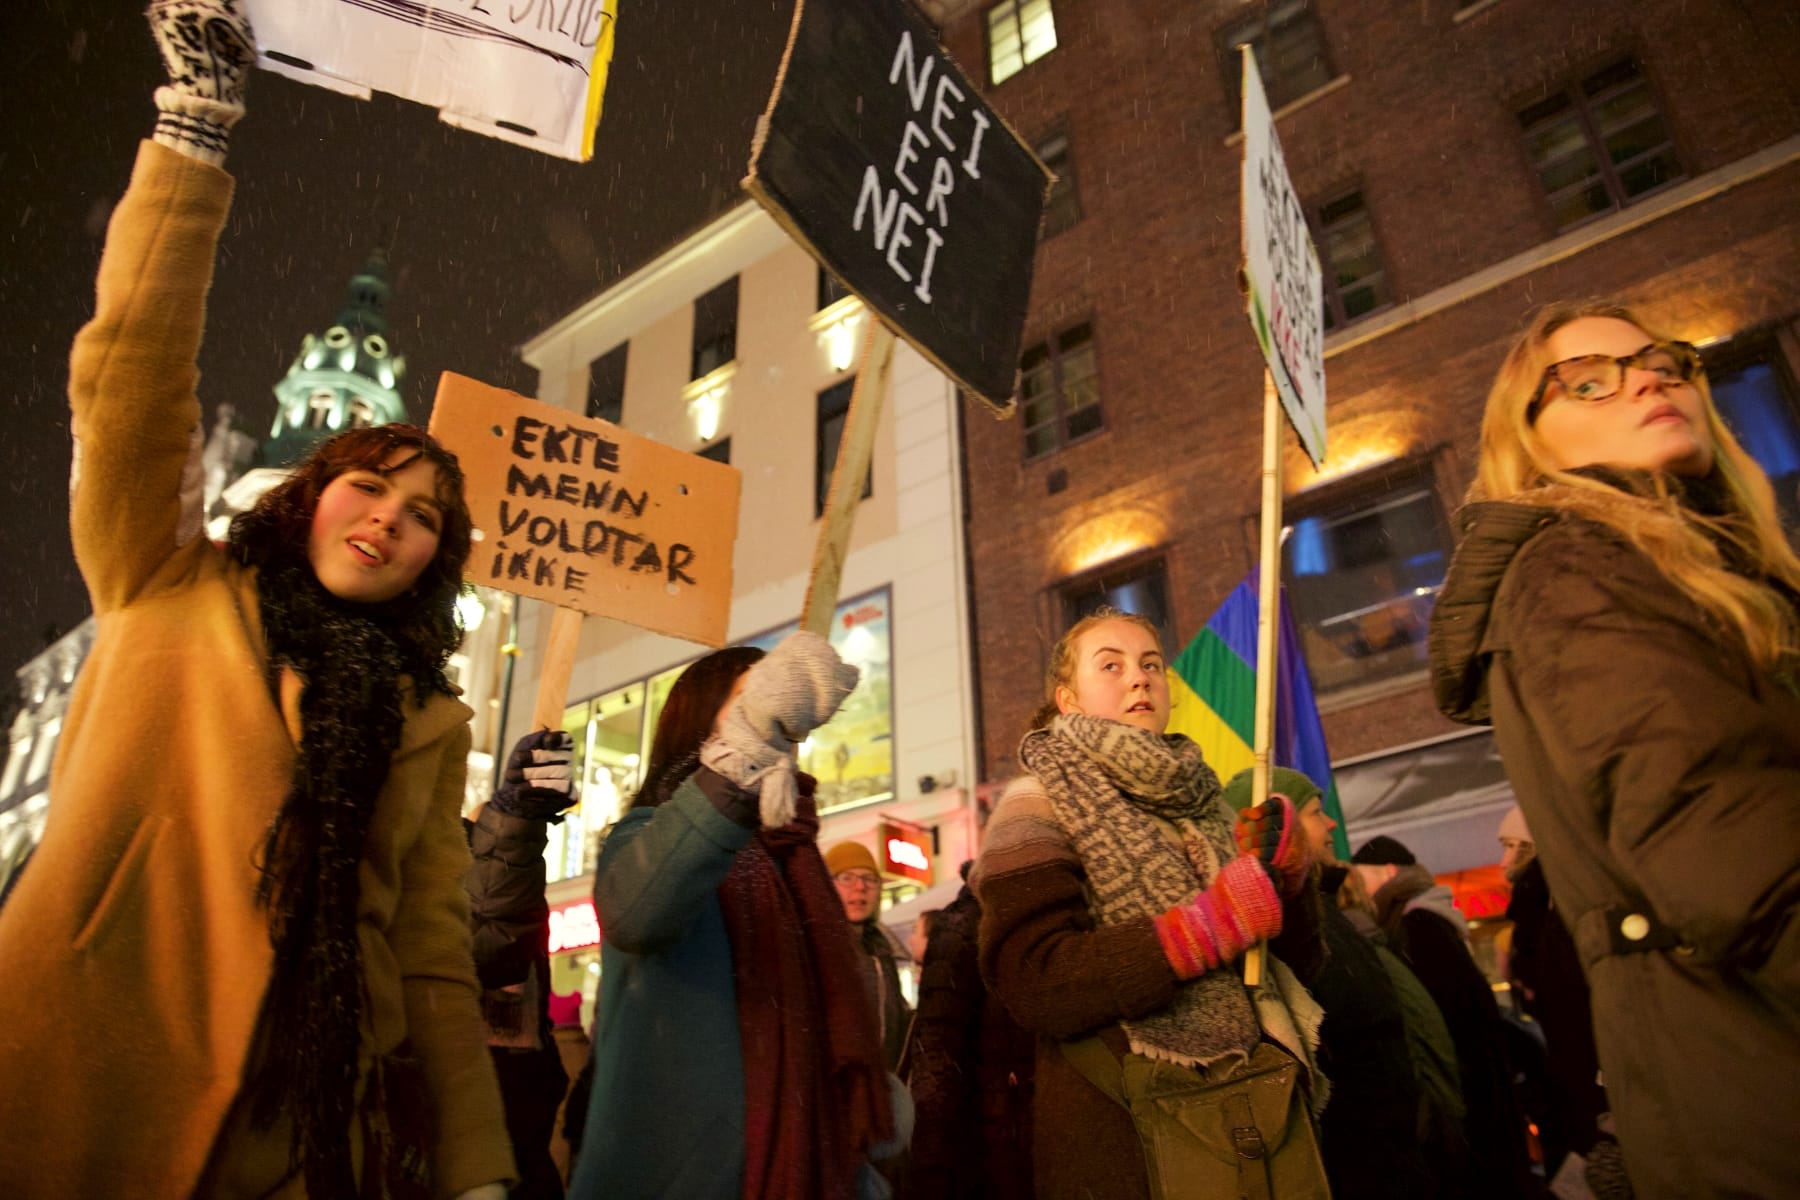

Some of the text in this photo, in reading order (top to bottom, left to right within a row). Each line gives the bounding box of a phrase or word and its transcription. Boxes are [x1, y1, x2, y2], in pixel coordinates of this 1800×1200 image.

[889, 30, 990, 180] NEI
[894, 120, 955, 227] ER
[852, 164, 944, 305] NEI
[505, 463, 649, 517] MENN
[511, 415, 621, 474] EKTE
[498, 499, 697, 586] VOLDTAR
